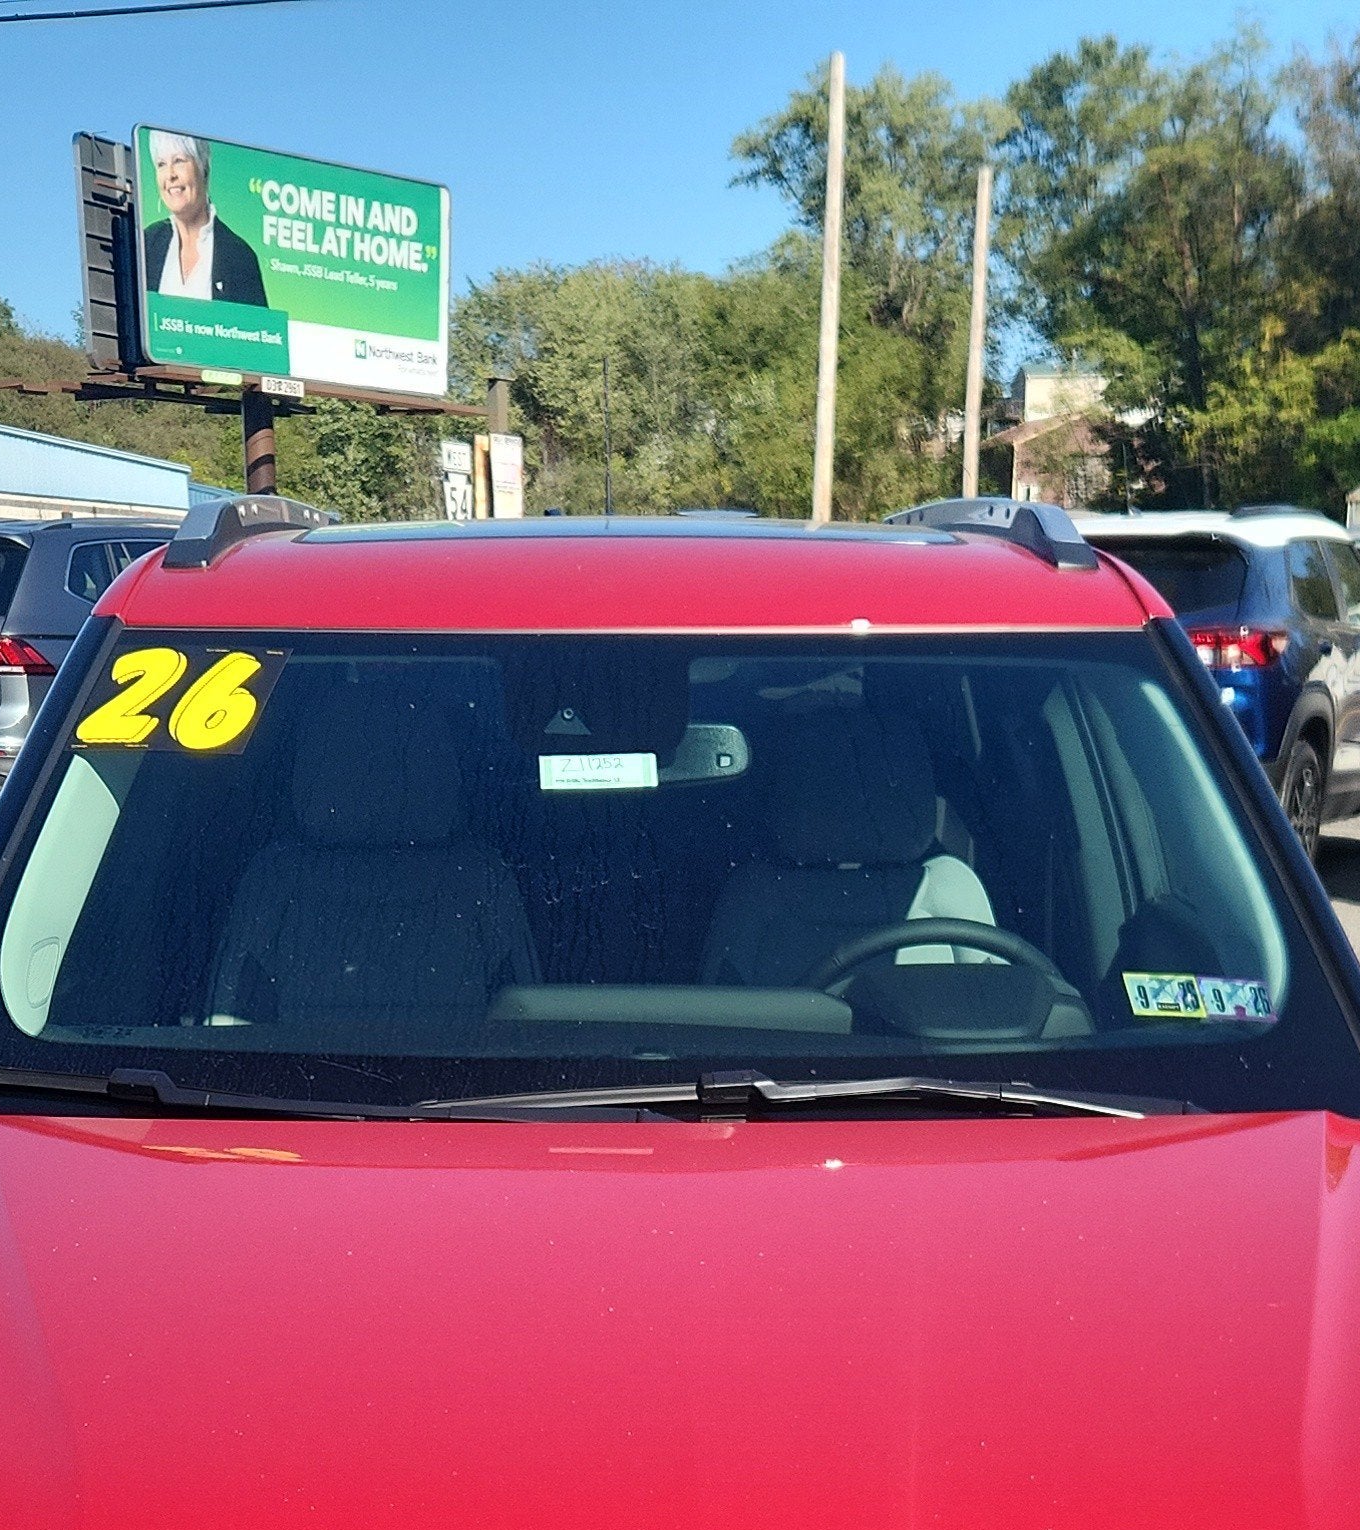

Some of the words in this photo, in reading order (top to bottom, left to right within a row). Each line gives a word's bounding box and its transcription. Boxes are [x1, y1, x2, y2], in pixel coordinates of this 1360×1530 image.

[339, 194, 365, 229] IN
[367, 200, 419, 237] AND
[262, 214, 320, 254] FEEL
[321, 226, 352, 259] AT
[185, 320, 193, 334] is
[193, 324, 214, 337] now
[214, 323, 260, 343] Northwest
[260, 329, 283, 346] Bank
[368, 345, 415, 363] Northwest
[417, 351, 438, 366] Bank
[446, 450, 467, 467] WEST
[450, 486, 469, 519] 54
[76, 647, 262, 750] 26
[1136, 985, 1150, 1010] 9
[1211, 988, 1226, 1013] 9
